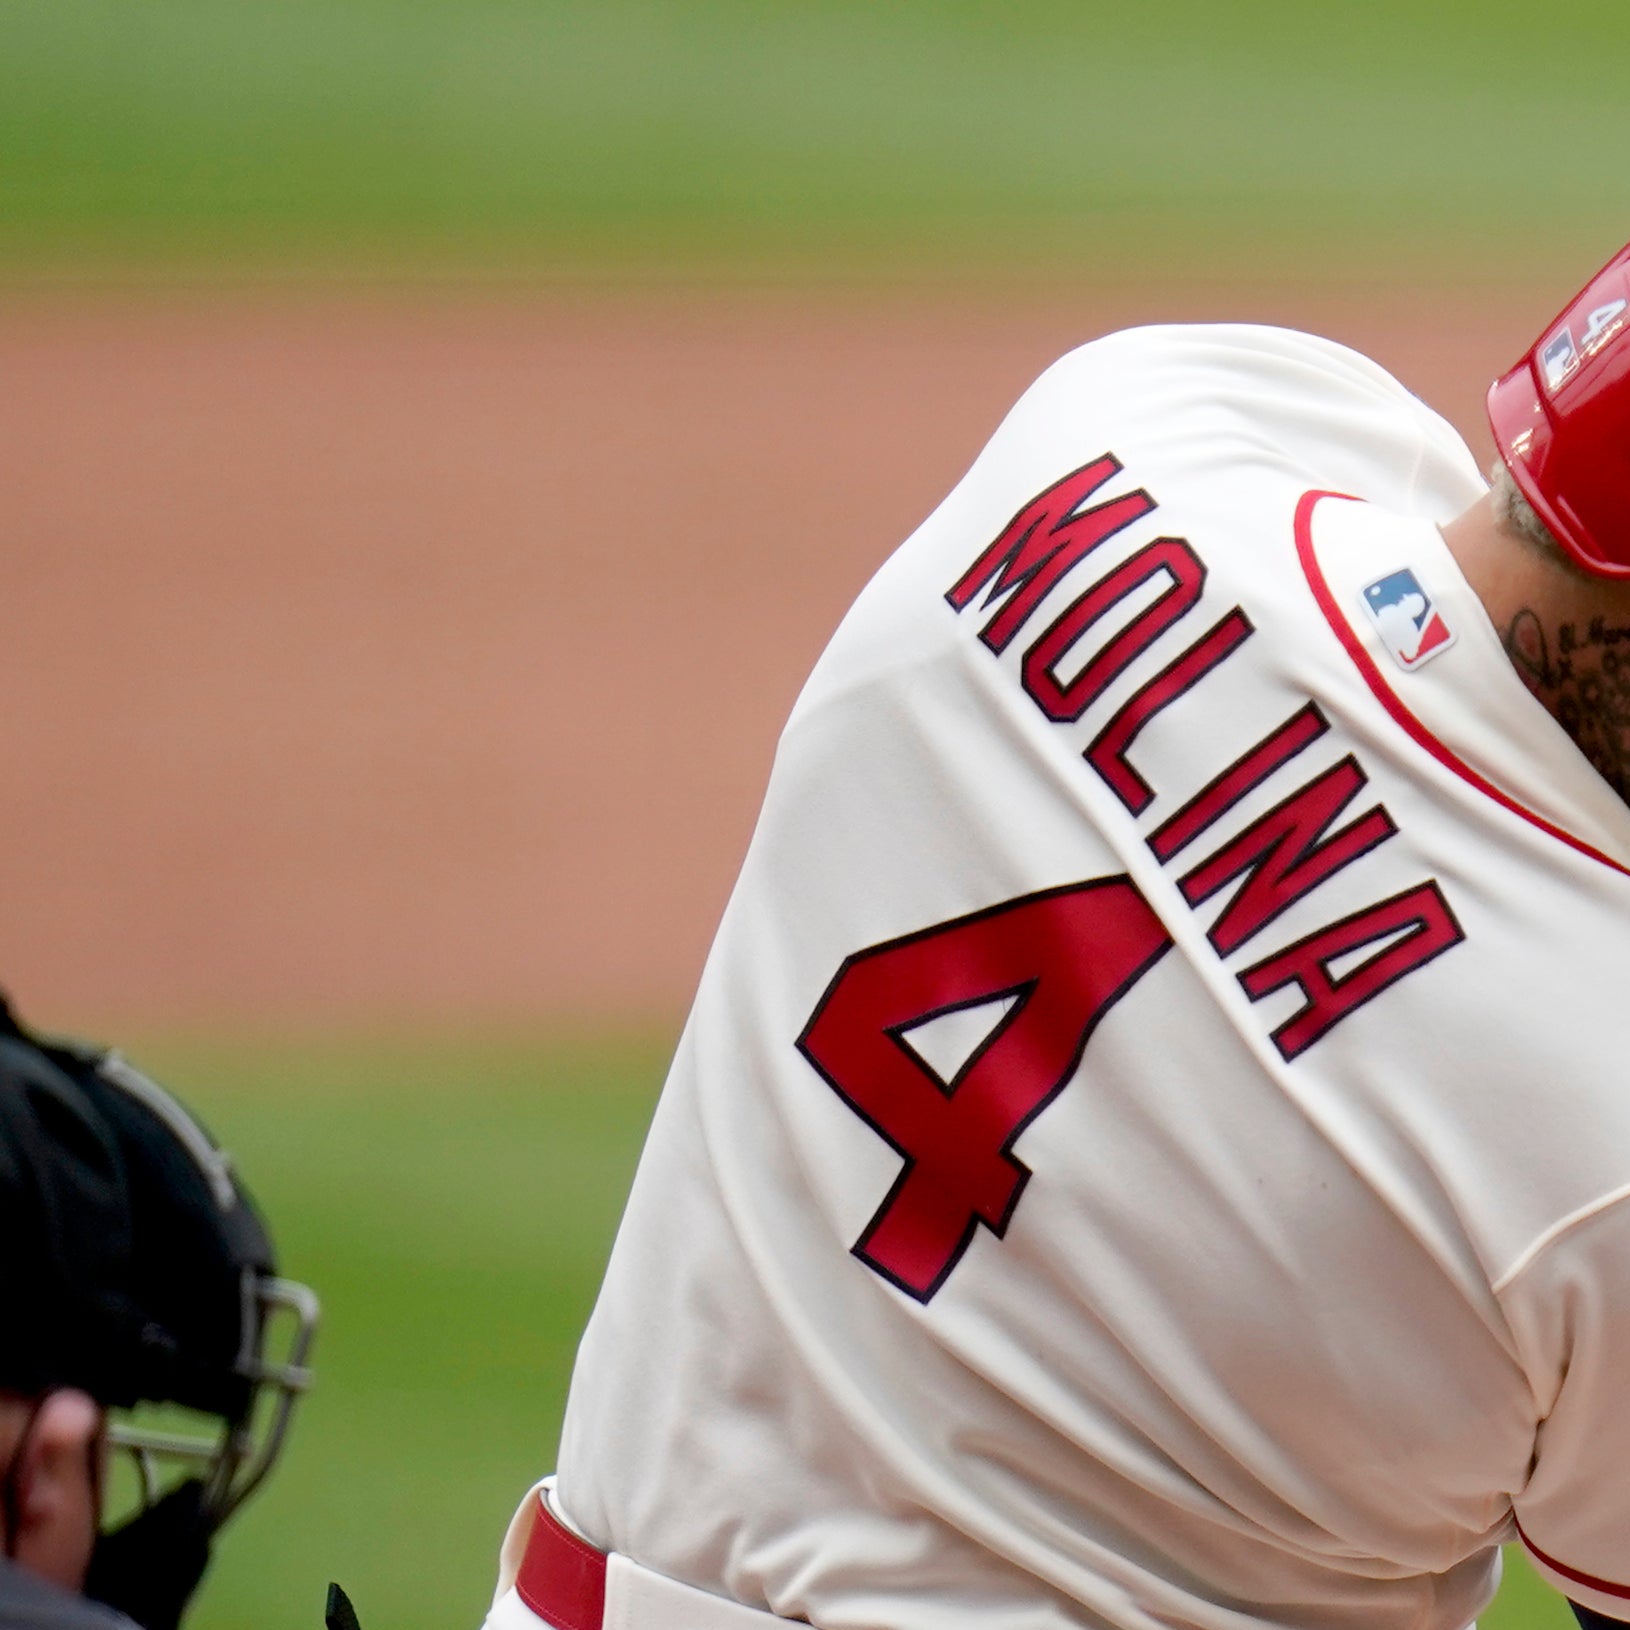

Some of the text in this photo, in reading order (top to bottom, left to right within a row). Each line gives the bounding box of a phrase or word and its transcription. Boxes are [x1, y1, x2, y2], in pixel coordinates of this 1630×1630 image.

[1580, 298, 1628, 346] 4
[944, 452, 1466, 1063] MOLINA
[793, 872, 1176, 1306] 4
